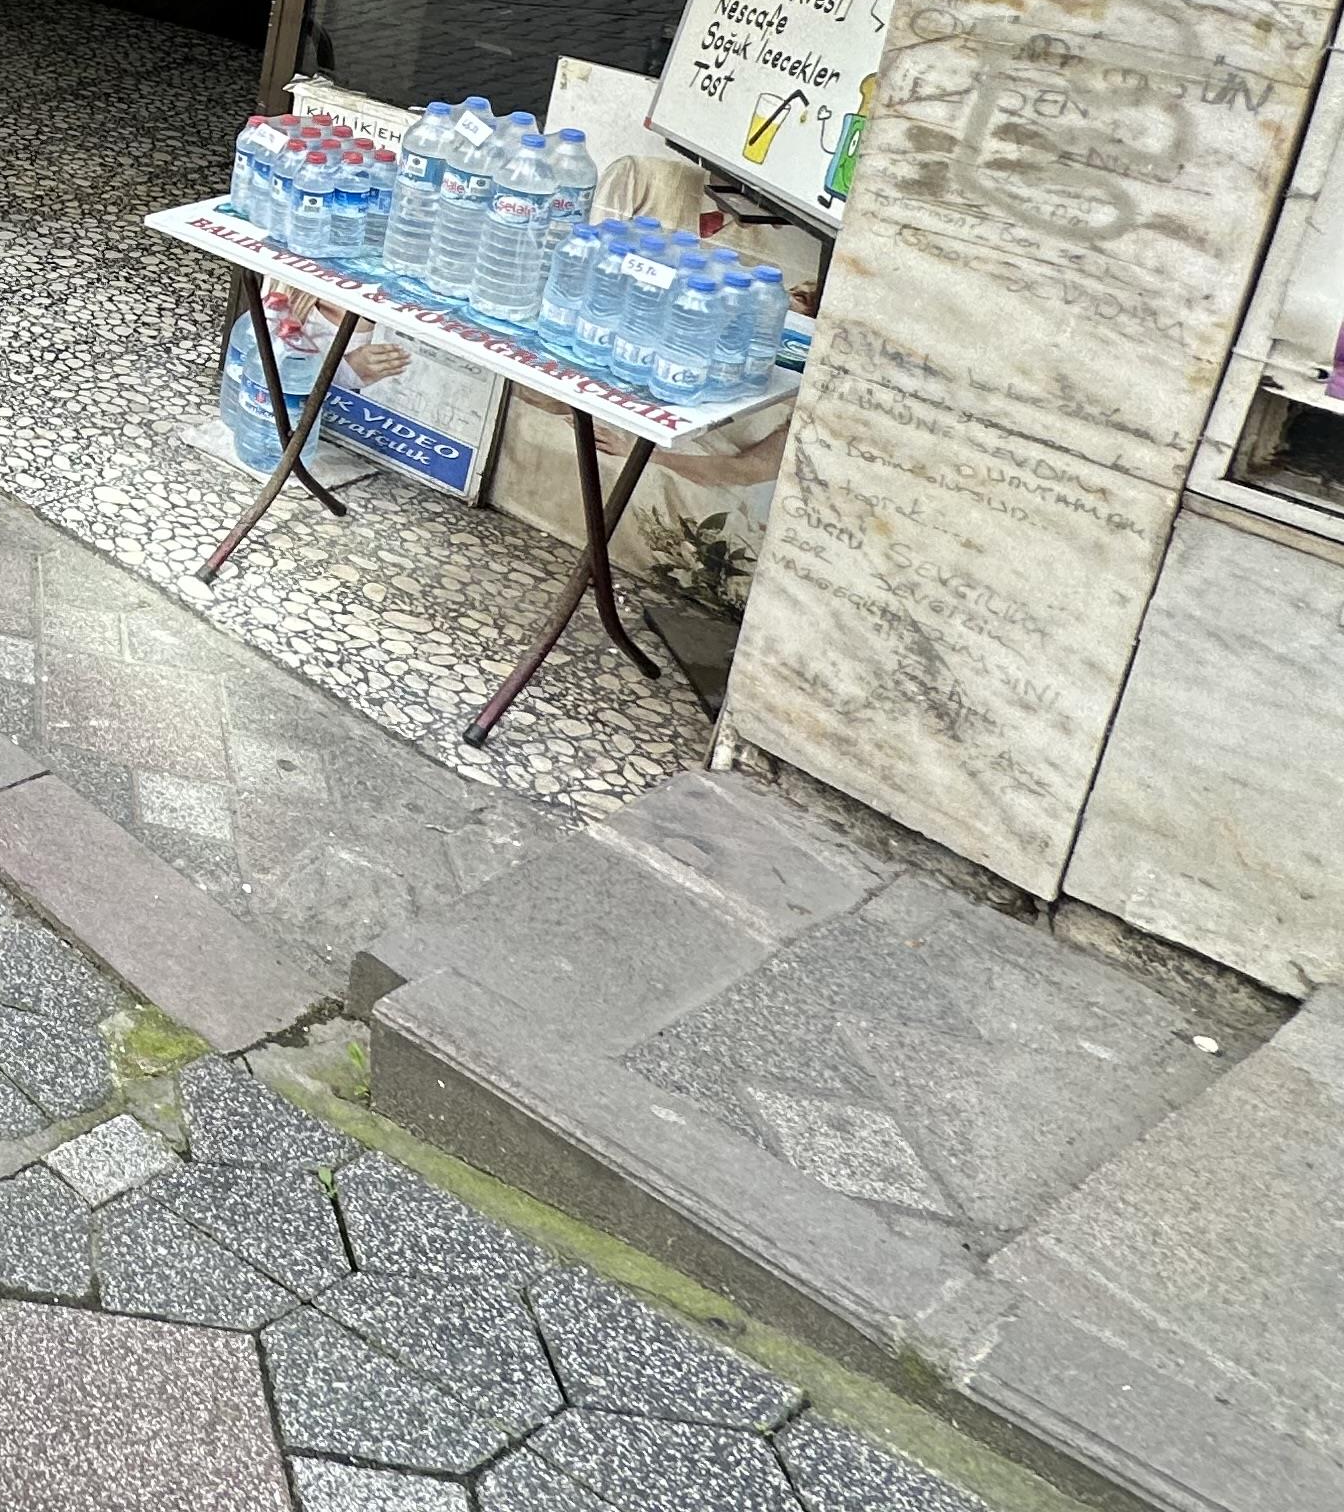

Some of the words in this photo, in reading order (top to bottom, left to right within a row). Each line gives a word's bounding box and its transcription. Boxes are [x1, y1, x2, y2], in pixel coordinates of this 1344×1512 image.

[700, 21, 753, 69] Soğuk
[689, 60, 735, 102] Tost
[185, 217, 268, 254] BALIK
[362, 406, 460, 460] VİDEO
